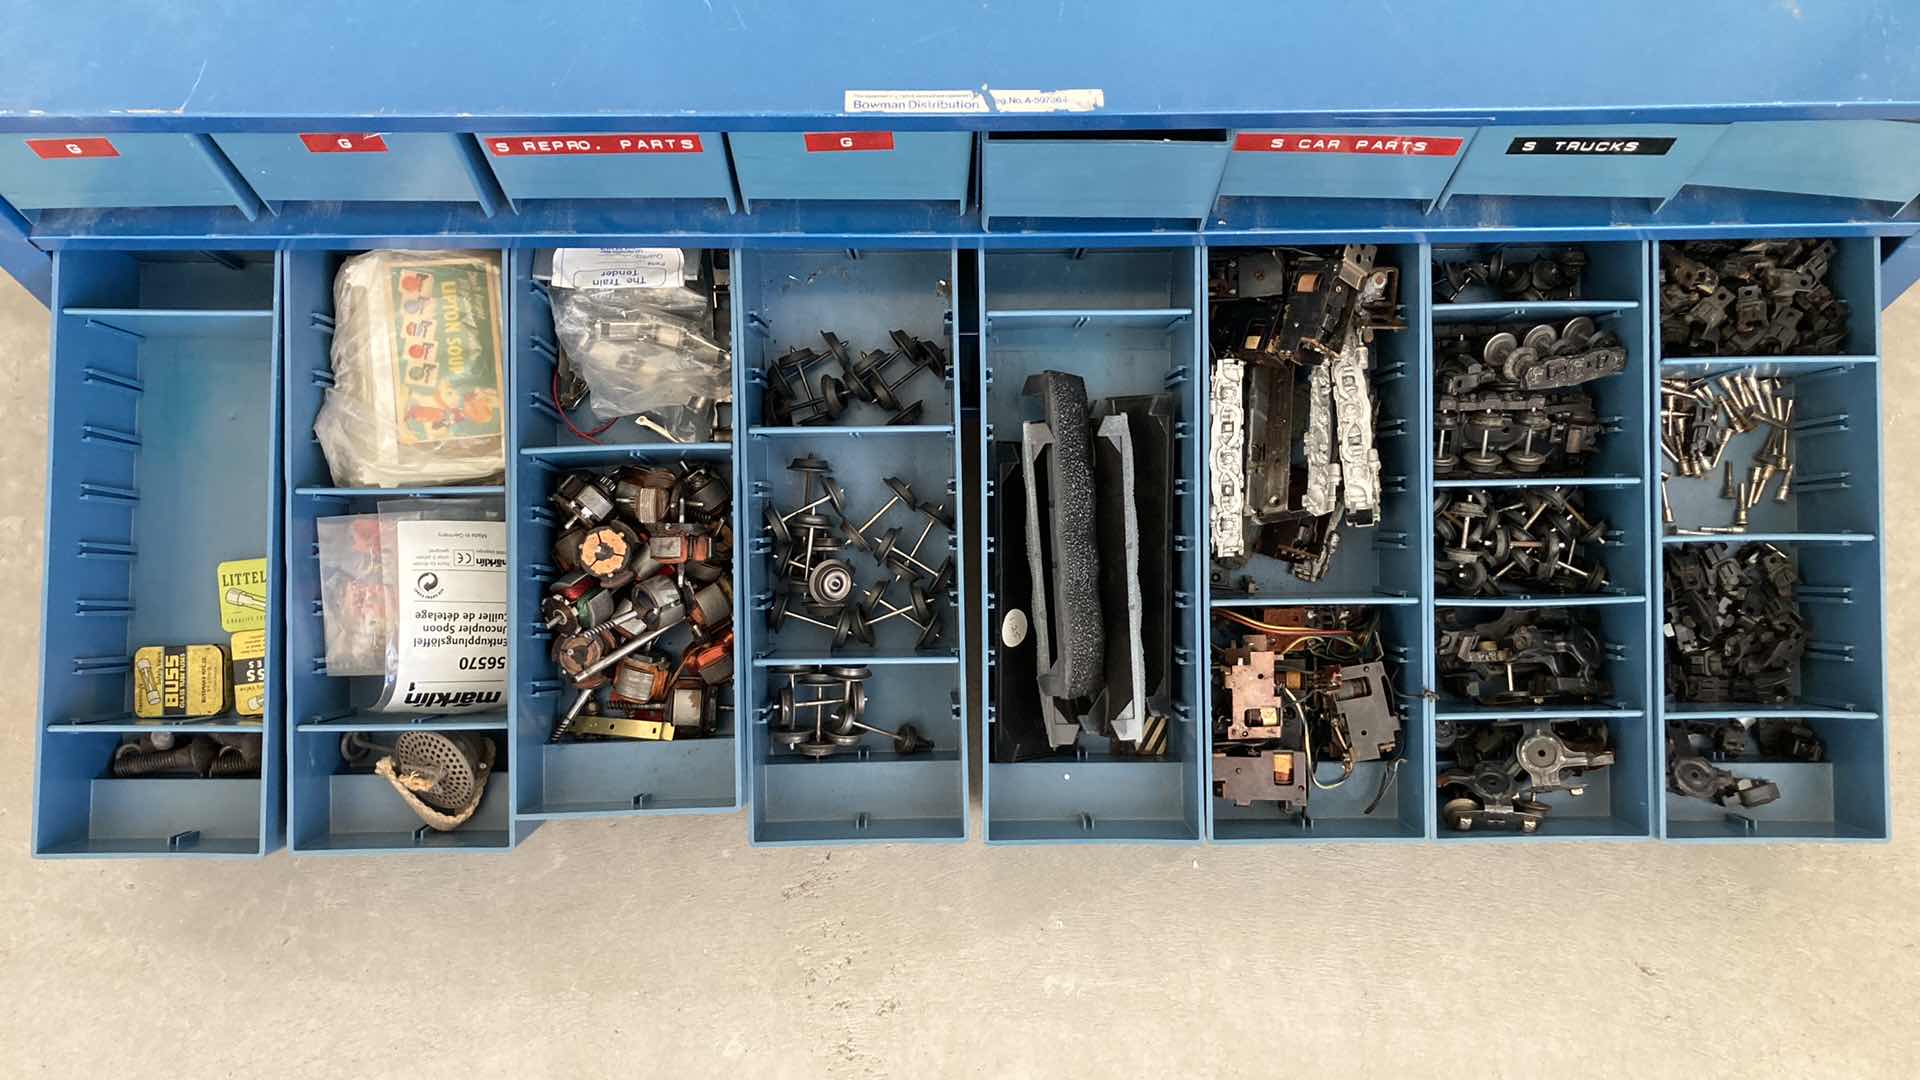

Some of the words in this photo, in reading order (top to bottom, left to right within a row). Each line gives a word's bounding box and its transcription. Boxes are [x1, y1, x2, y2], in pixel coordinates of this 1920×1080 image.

[853, 99, 906, 110] Bowman
[908, 99, 980, 110] Distribution
[337, 138, 353, 149] G
[495, 142, 510, 152] S
[522, 140, 601, 152] REPRO.
[620, 139, 695, 150] PARTS
[840, 137, 853, 148] G
[1270, 138, 1285, 149] S
[1298, 138, 1341, 150] CAR
[1355, 139, 1429, 152] PARTS
[1521, 141, 1537, 151] S
[1555, 141, 1640, 152] TRUCKS
[65, 143, 82, 154] G
[600, 269, 640, 277] Tender
[592, 277, 621, 286] Train
[625, 276, 647, 285] The
[446, 335, 465, 375] SOUP
[415, 609, 460, 622] dételage
[463, 611, 476, 621] de
[422, 623, 456, 634] Spoon
[459, 656, 506, 670] 56570
[164, 655, 180, 707] BUSS
[404, 691, 502, 707] märklin
